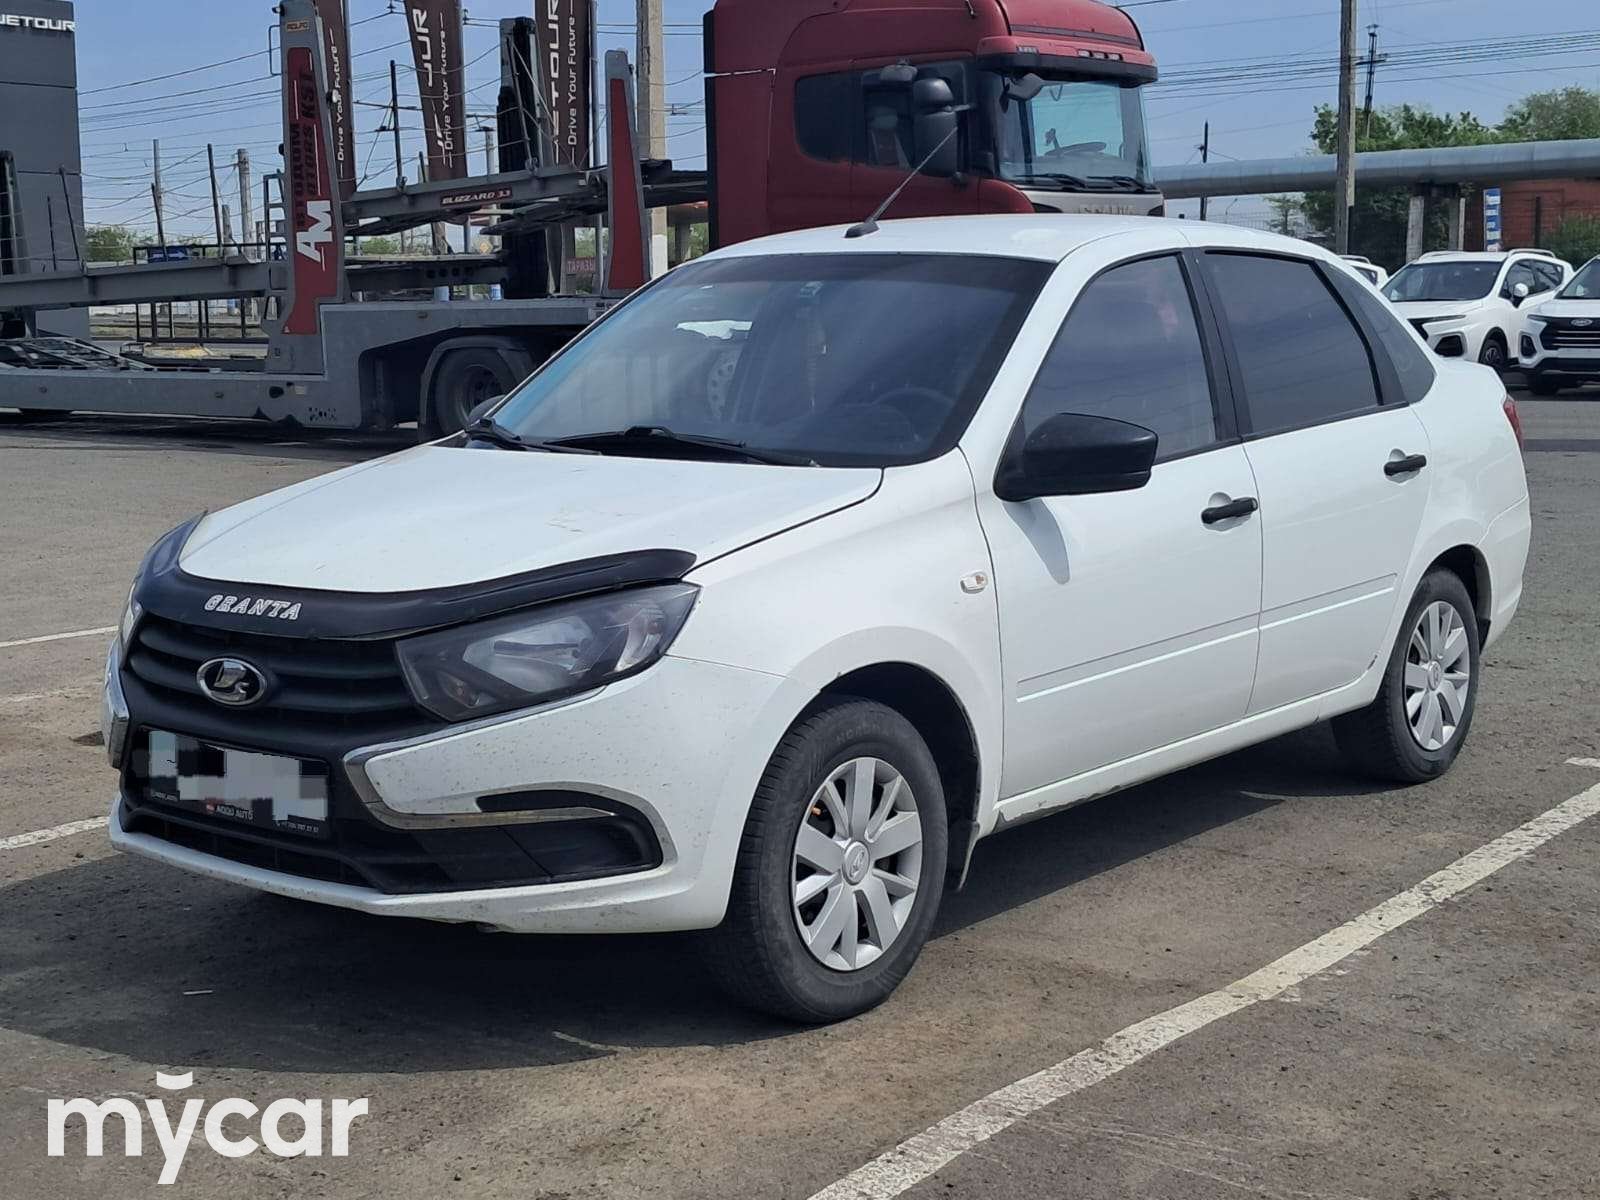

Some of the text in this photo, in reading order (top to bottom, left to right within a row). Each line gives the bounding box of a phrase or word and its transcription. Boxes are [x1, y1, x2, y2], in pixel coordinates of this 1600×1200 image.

[0, 14, 76, 32] JETOUR
[330, 46, 341, 88] Future
[568, 17, 577, 146] Drive Your Future
[442, 80, 450, 111] Your
[337, 126, 345, 161] Drive
[443, 115, 454, 150] Drive
[204, 595, 302, 619] GRANTA
